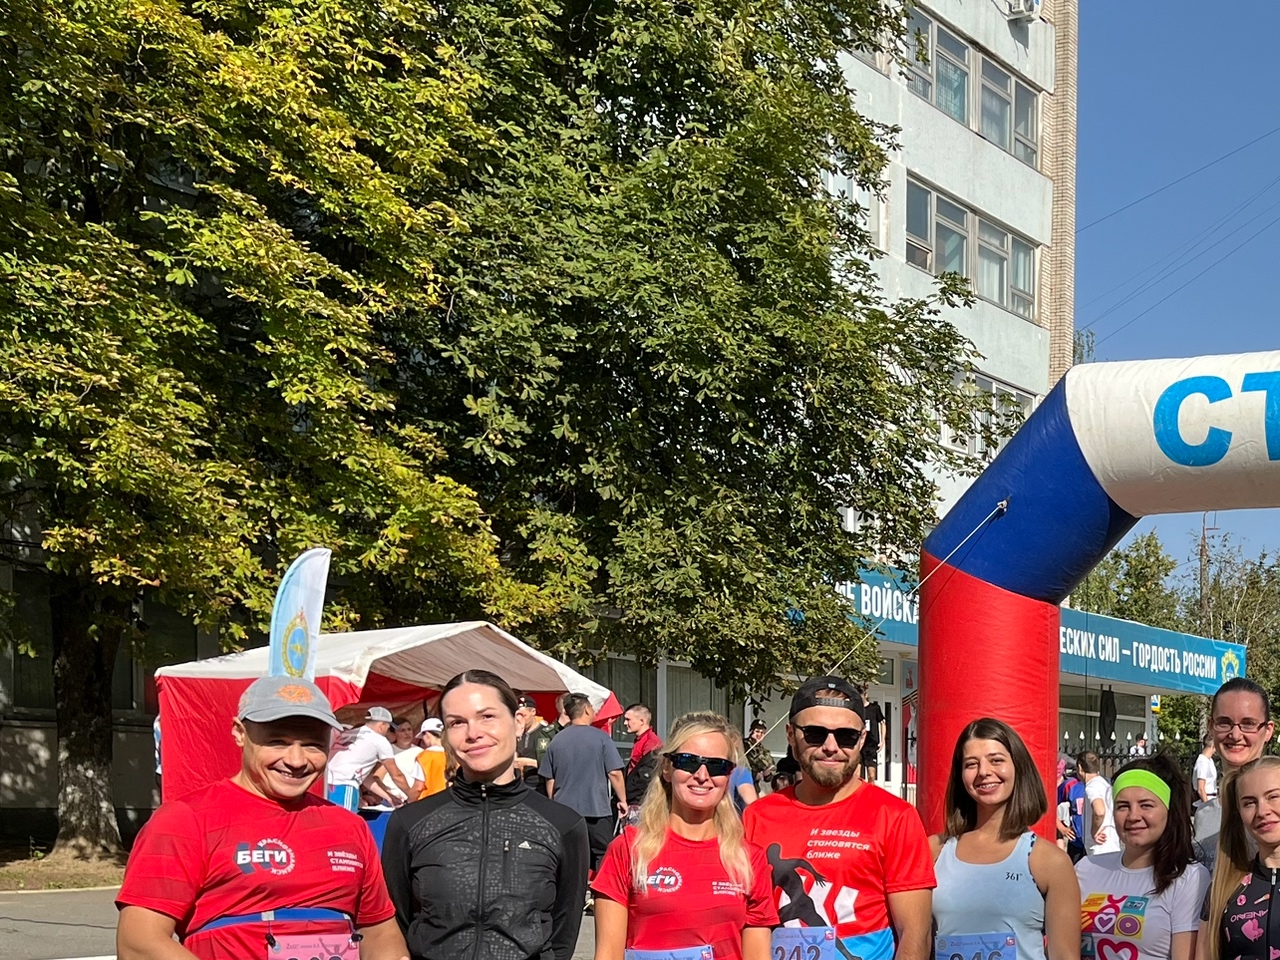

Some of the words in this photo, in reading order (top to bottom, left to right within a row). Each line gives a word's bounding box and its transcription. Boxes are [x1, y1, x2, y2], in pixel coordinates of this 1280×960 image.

[1098, 634, 1120, 664] СИЛ
[1132, 641, 1181, 674] ГОРДОСТЬ
[1183, 651, 1217, 680] РОССИИ
[810, 828, 818, 836] И
[820, 828, 860, 838] звезды
[807, 839, 870, 851] становятся
[236, 850, 287, 865] БЕГИ
[806, 850, 841, 860] ближе
[642, 874, 676, 885] ЕГИ
